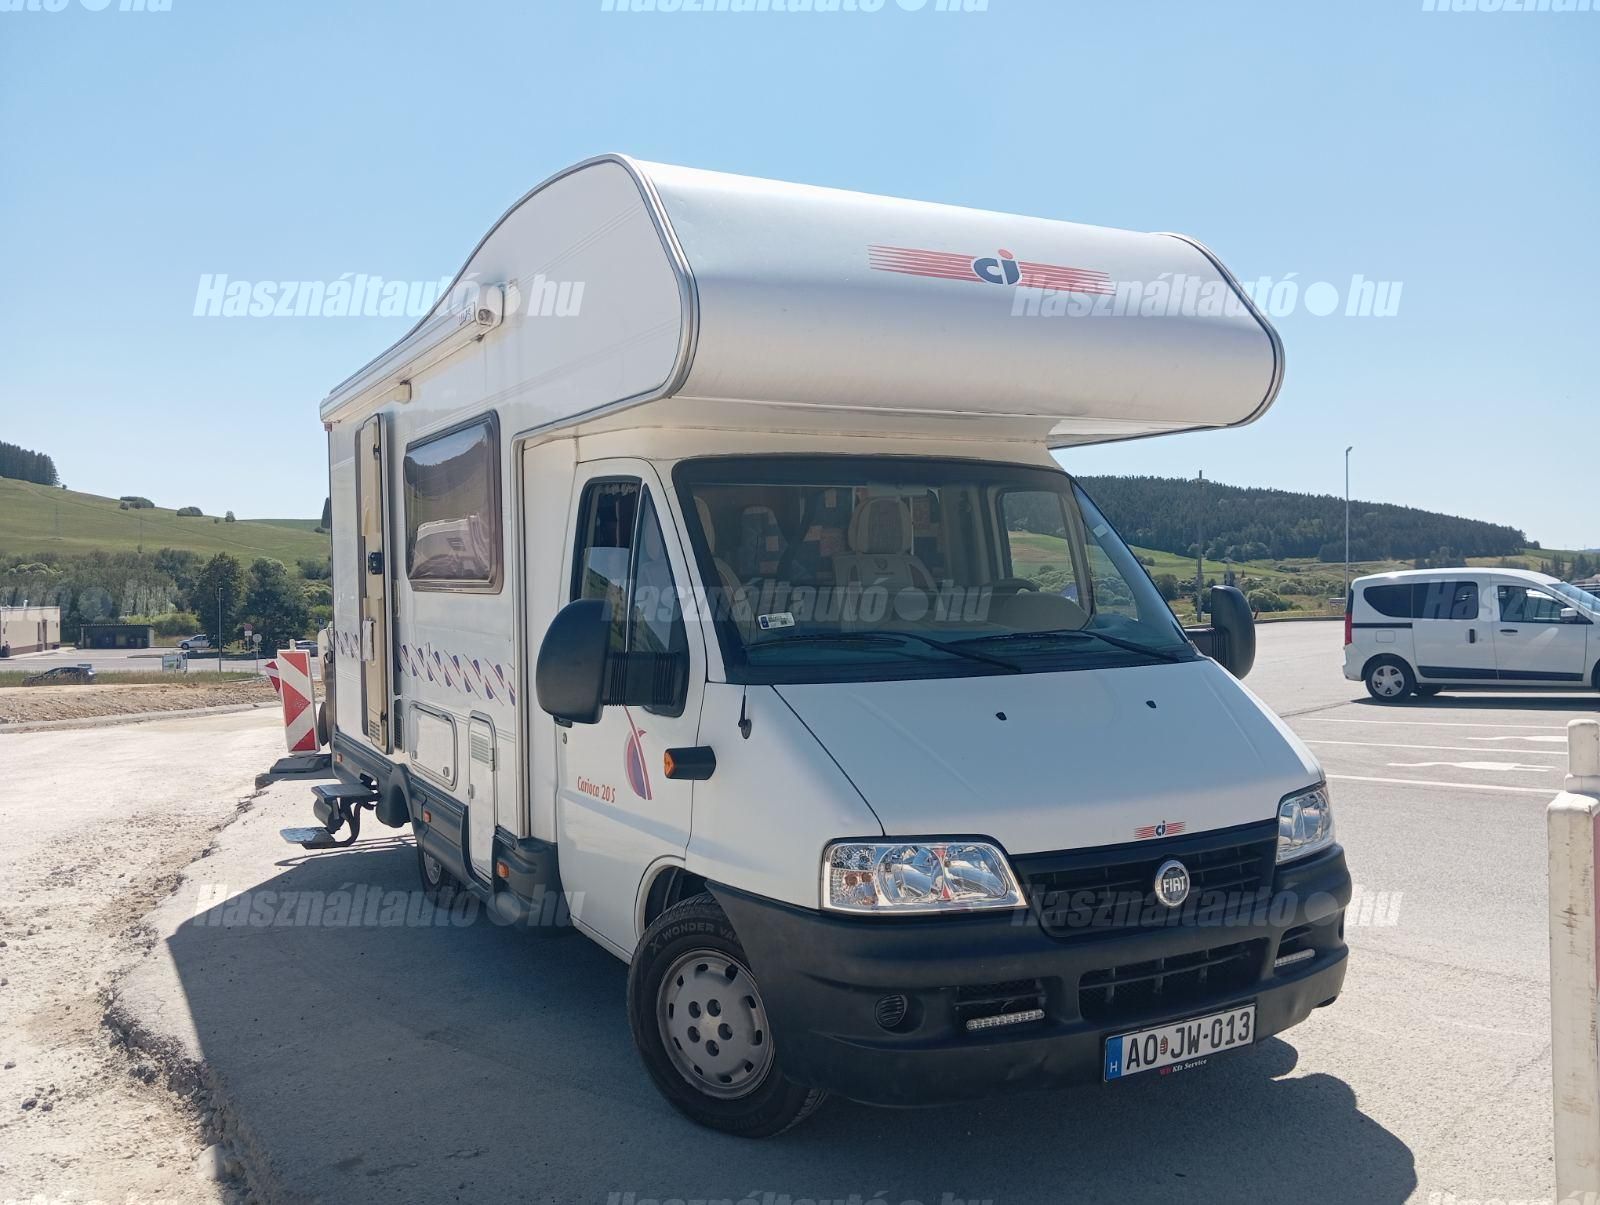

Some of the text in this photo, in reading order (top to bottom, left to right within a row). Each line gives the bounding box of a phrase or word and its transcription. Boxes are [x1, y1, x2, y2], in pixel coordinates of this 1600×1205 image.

[1163, 876, 1186, 894] FIAT
[662, 922, 715, 940] WONDER
[1126, 1033, 1158, 1071] AO
[1109, 1061, 1119, 1073] H
